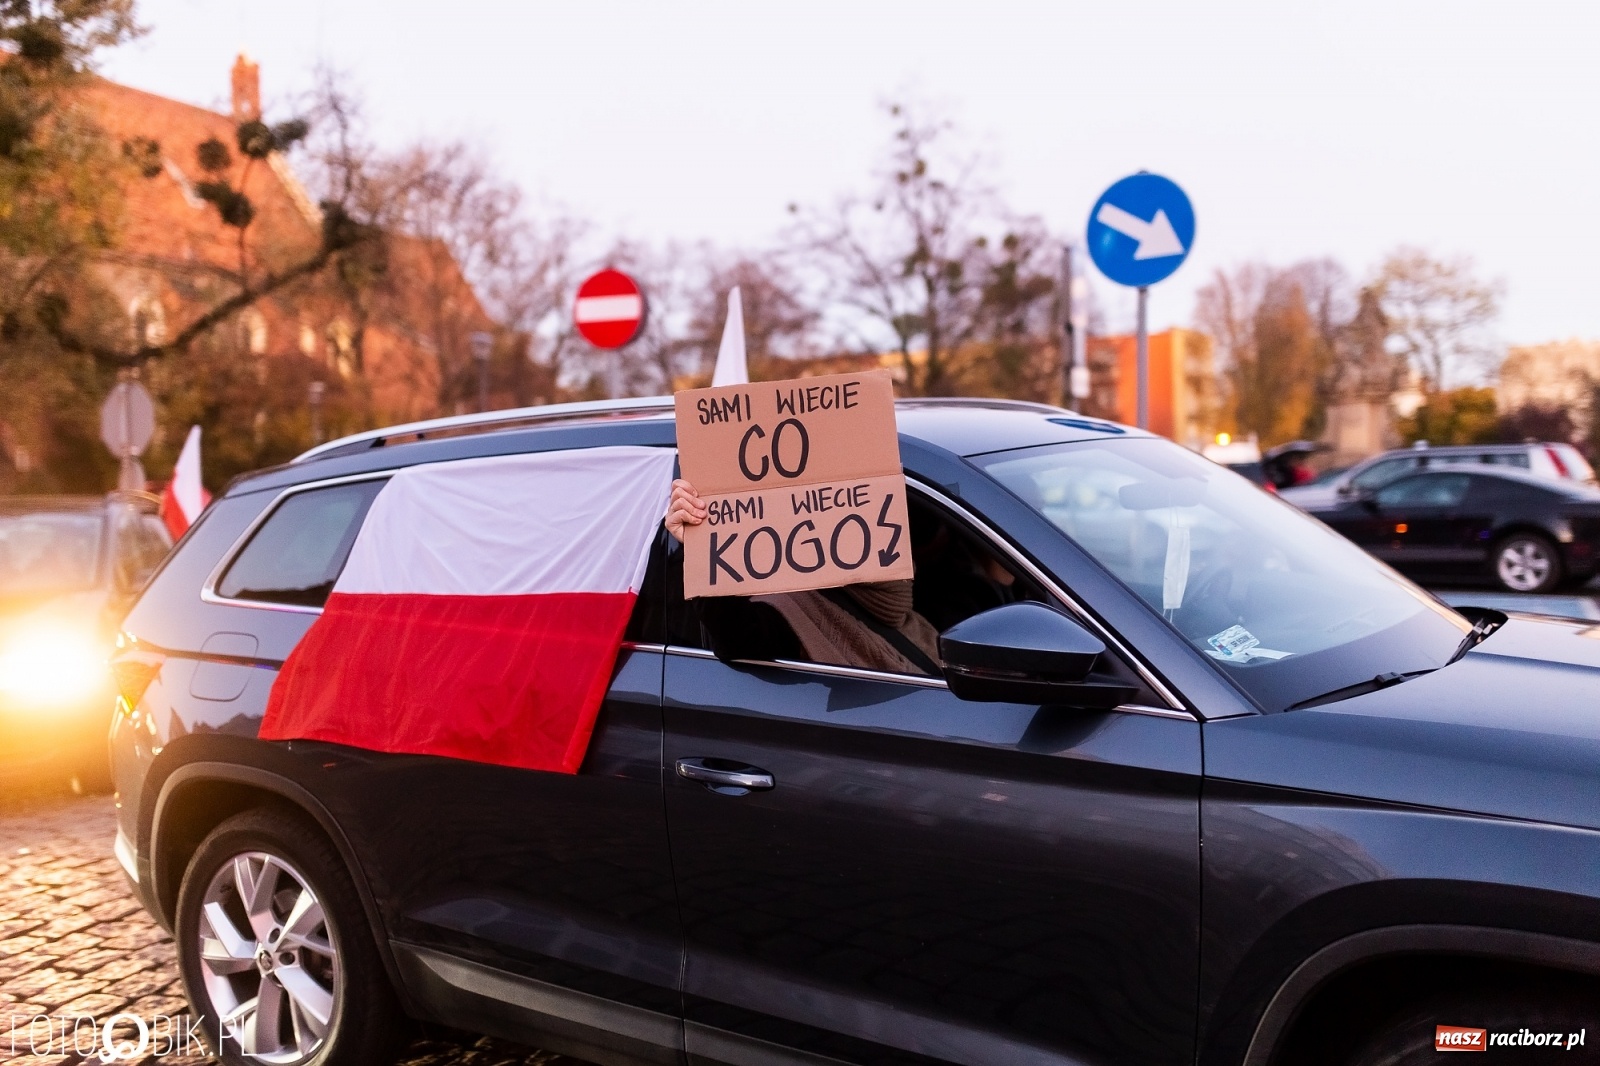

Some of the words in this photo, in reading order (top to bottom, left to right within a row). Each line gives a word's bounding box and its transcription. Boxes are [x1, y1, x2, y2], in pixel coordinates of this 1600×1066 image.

[697, 394, 751, 425] SAMI
[776, 381, 861, 415] WIECIE
[738, 418, 809, 481] CO
[708, 496, 764, 526] SAMI
[791, 484, 870, 515] WIECIE
[709, 513, 871, 586] KOGO
